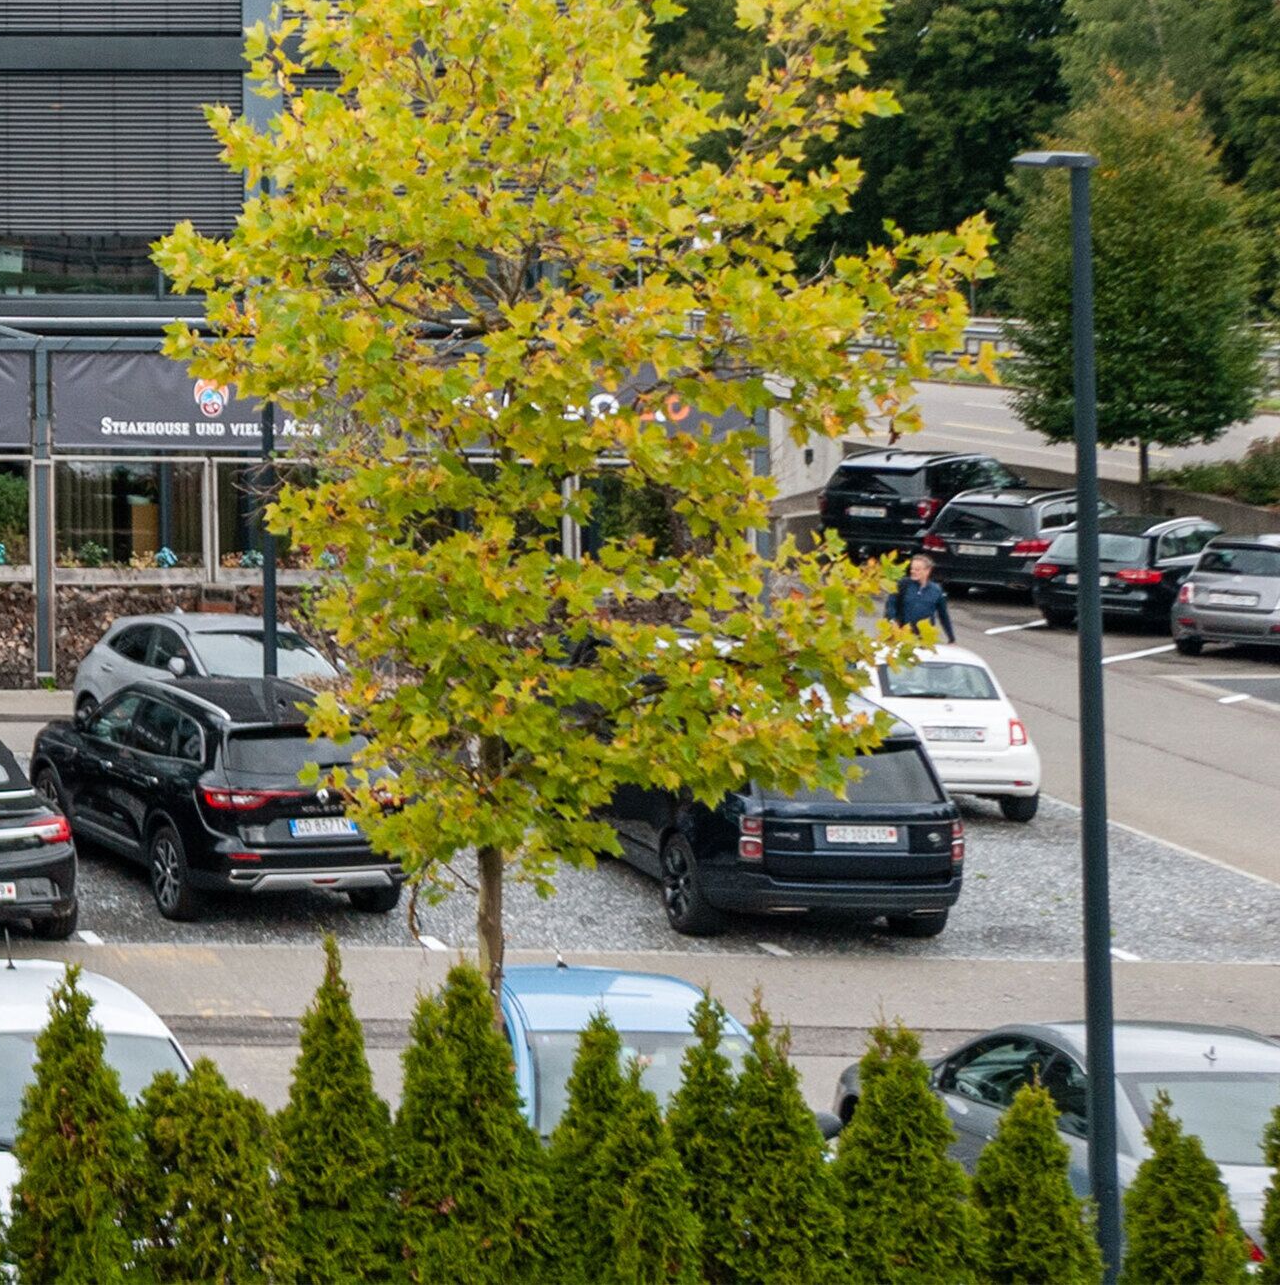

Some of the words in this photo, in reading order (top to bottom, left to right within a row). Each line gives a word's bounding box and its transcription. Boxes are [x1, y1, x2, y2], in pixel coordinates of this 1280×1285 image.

[100, 416, 190, 436] STEAKHOUSE
[195, 422, 226, 436] UND
[230, 422, 276, 436] VIEL
